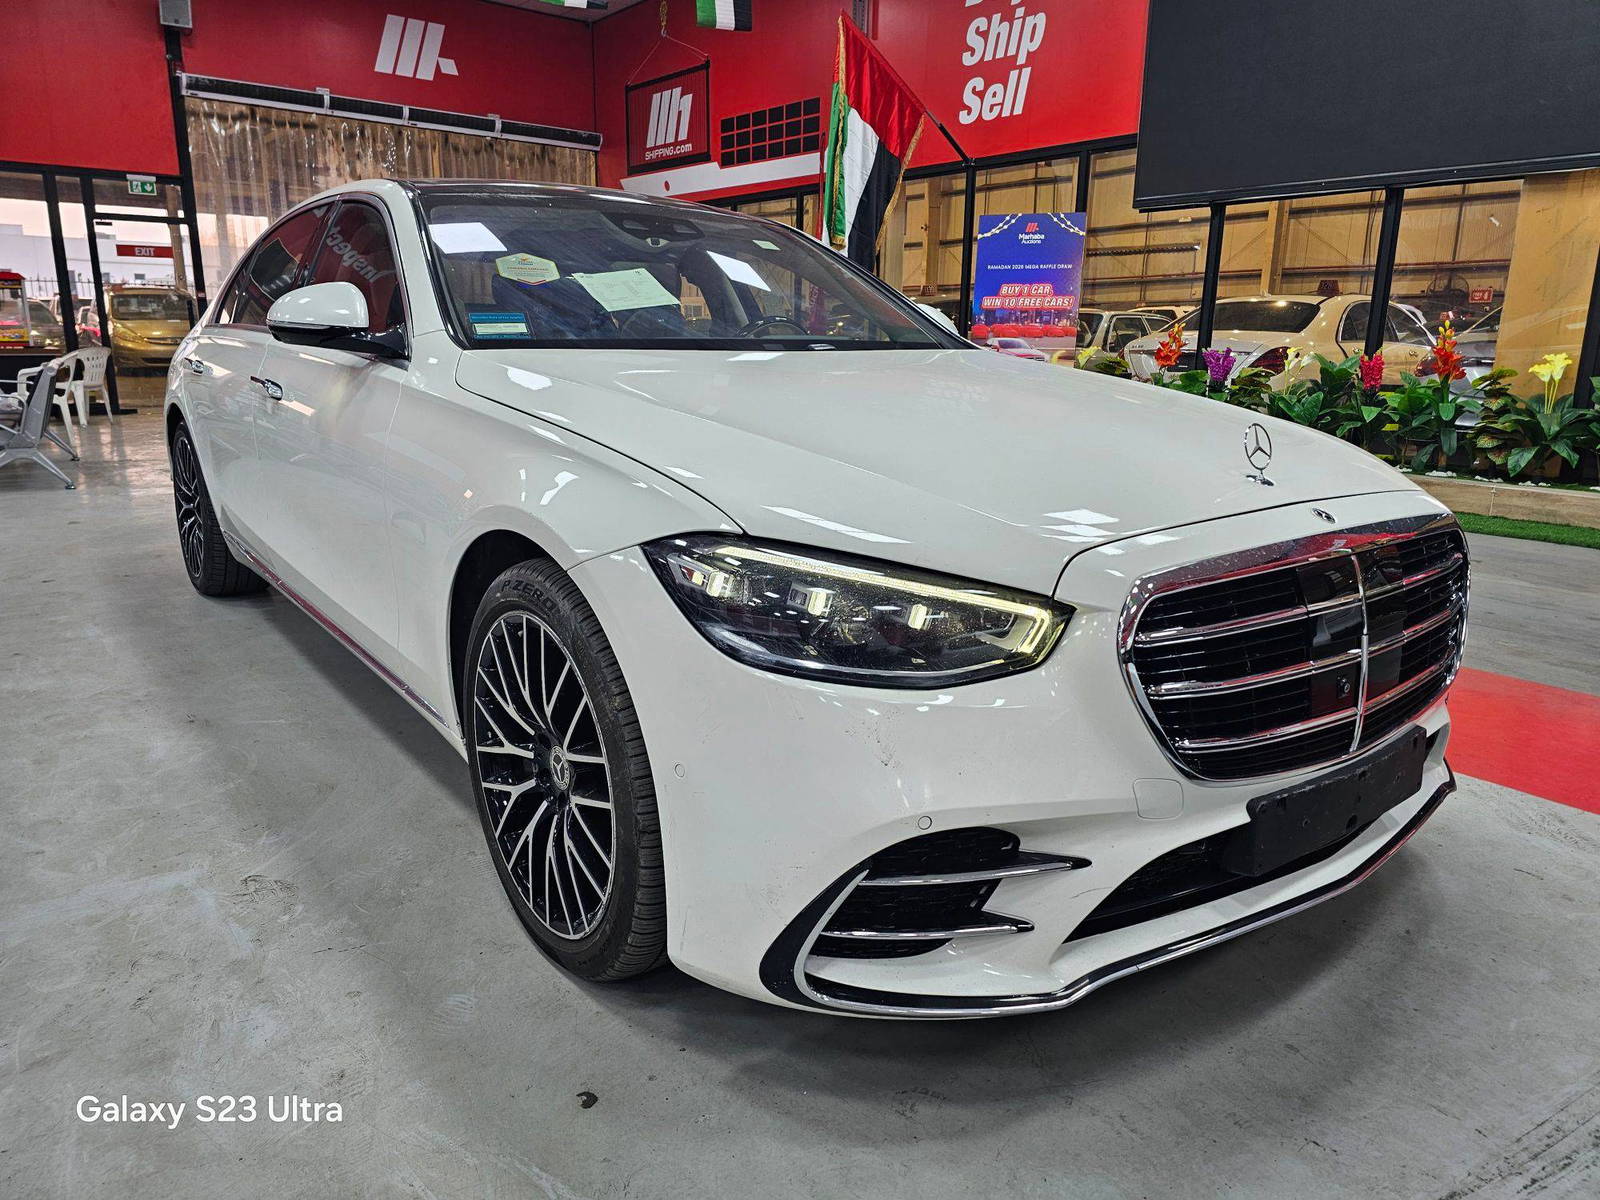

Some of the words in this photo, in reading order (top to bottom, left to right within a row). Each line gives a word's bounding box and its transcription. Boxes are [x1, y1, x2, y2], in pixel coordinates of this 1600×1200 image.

[962, 6, 1046, 66] Ship
[959, 66, 1032, 125] Sell
[645, 143, 692, 160] SHIPPING.com
[134, 247, 155, 257] EXIT
[1002, 286, 1020, 294] BUY
[1023, 286, 1028, 294] 1
[983, 298, 1001, 307] WIN
[1005, 298, 1016, 307] 10
[1018, 298, 1041, 307] FREE
[1044, 297, 1074, 307] CARS!
[512, 580, 557, 611] ZERO
